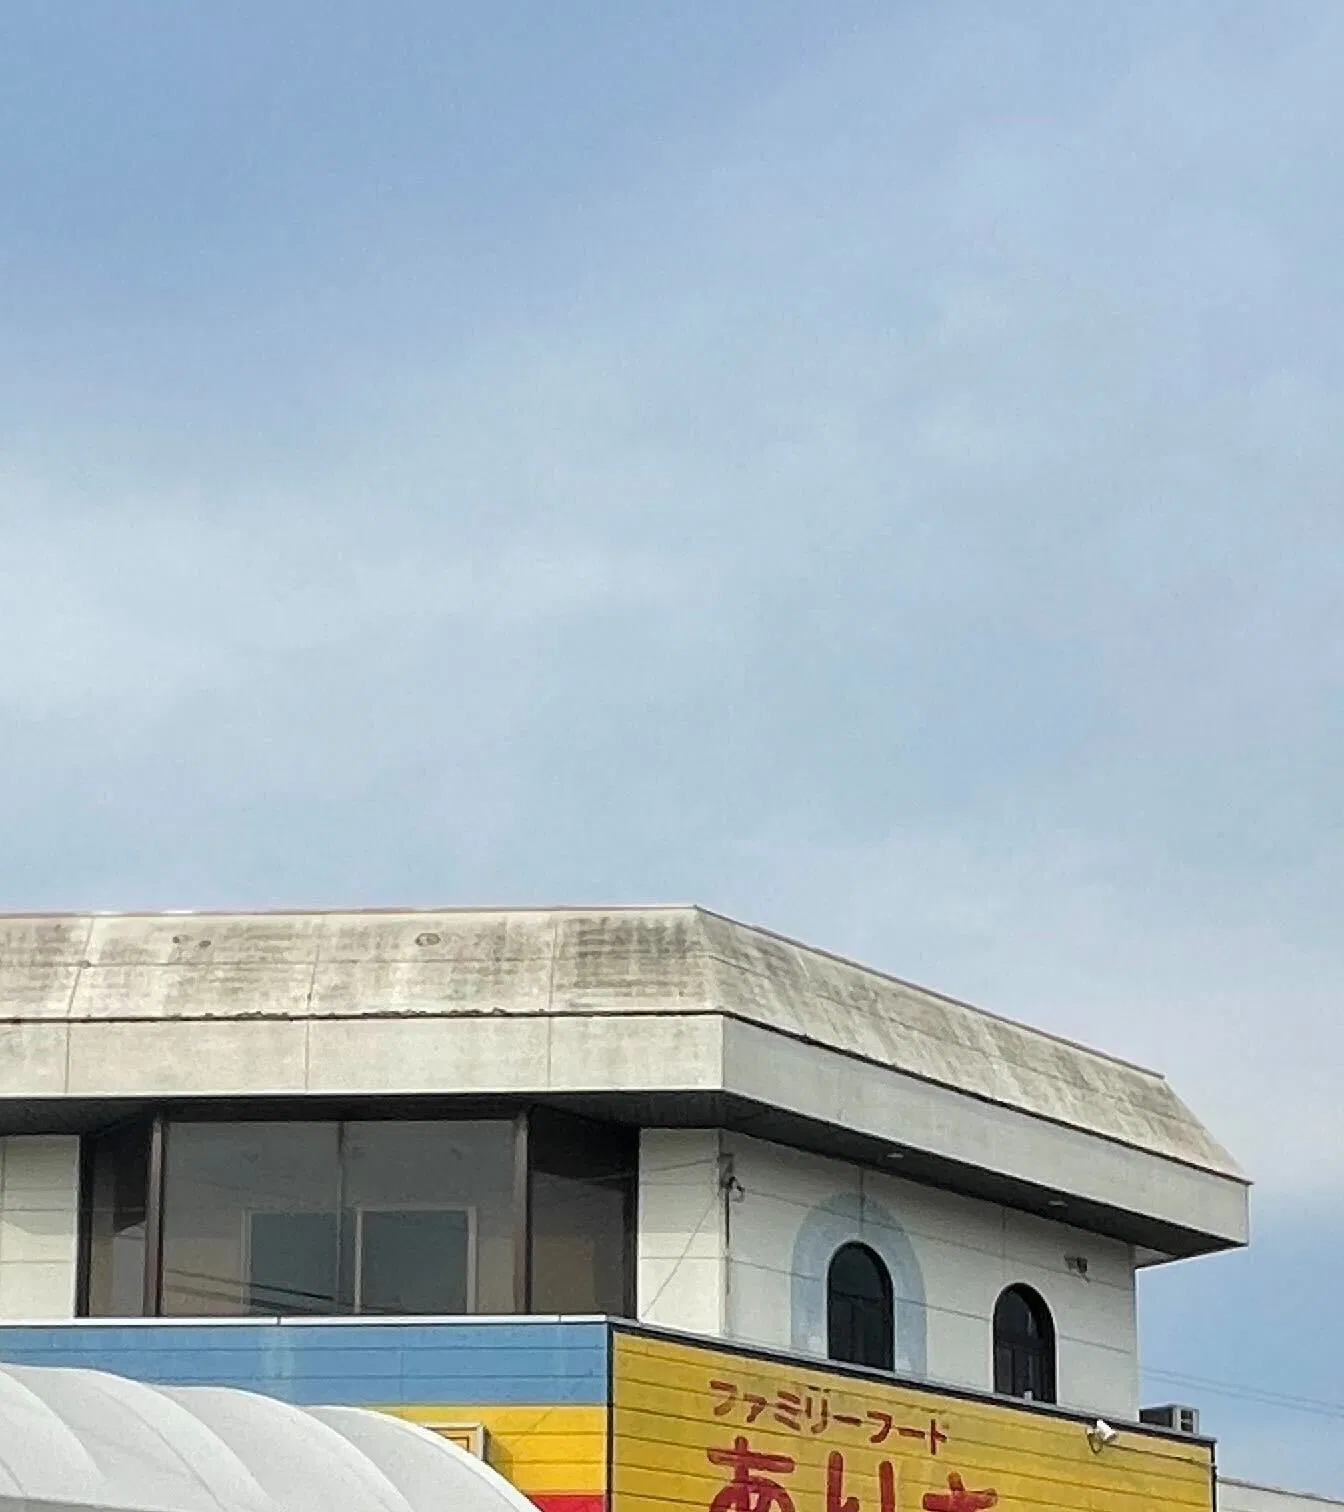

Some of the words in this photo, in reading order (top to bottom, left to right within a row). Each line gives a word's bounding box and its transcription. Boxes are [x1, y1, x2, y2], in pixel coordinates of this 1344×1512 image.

[709, 1379, 951, 1456] ファミリーフード
